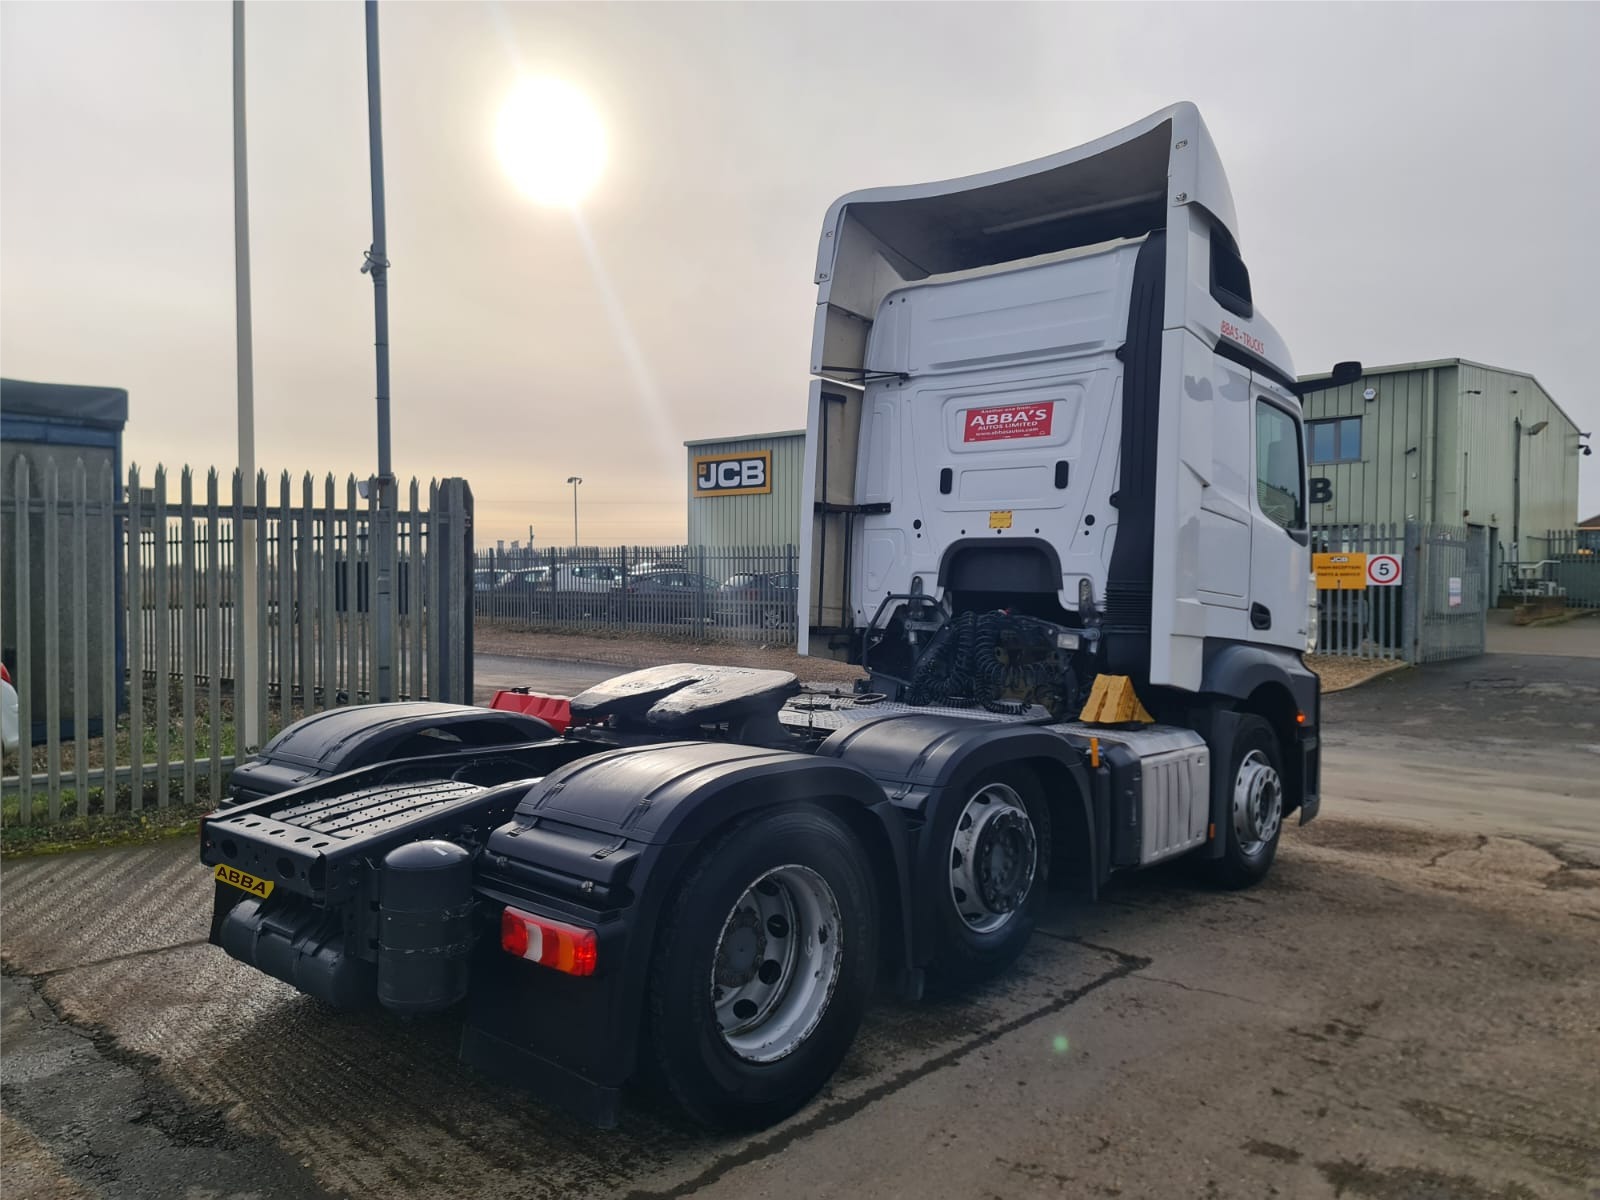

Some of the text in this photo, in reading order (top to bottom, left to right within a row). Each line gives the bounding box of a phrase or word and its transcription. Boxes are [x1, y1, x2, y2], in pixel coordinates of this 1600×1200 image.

[970, 409, 1047, 426] ABBA'S
[1005, 420, 1038, 429] LIMITED
[975, 427, 1039, 437] www.abbasautos.com
[698, 460, 765, 489] JCB
[1378, 563, 1390, 576] 5
[216, 866, 265, 895] ABBA
